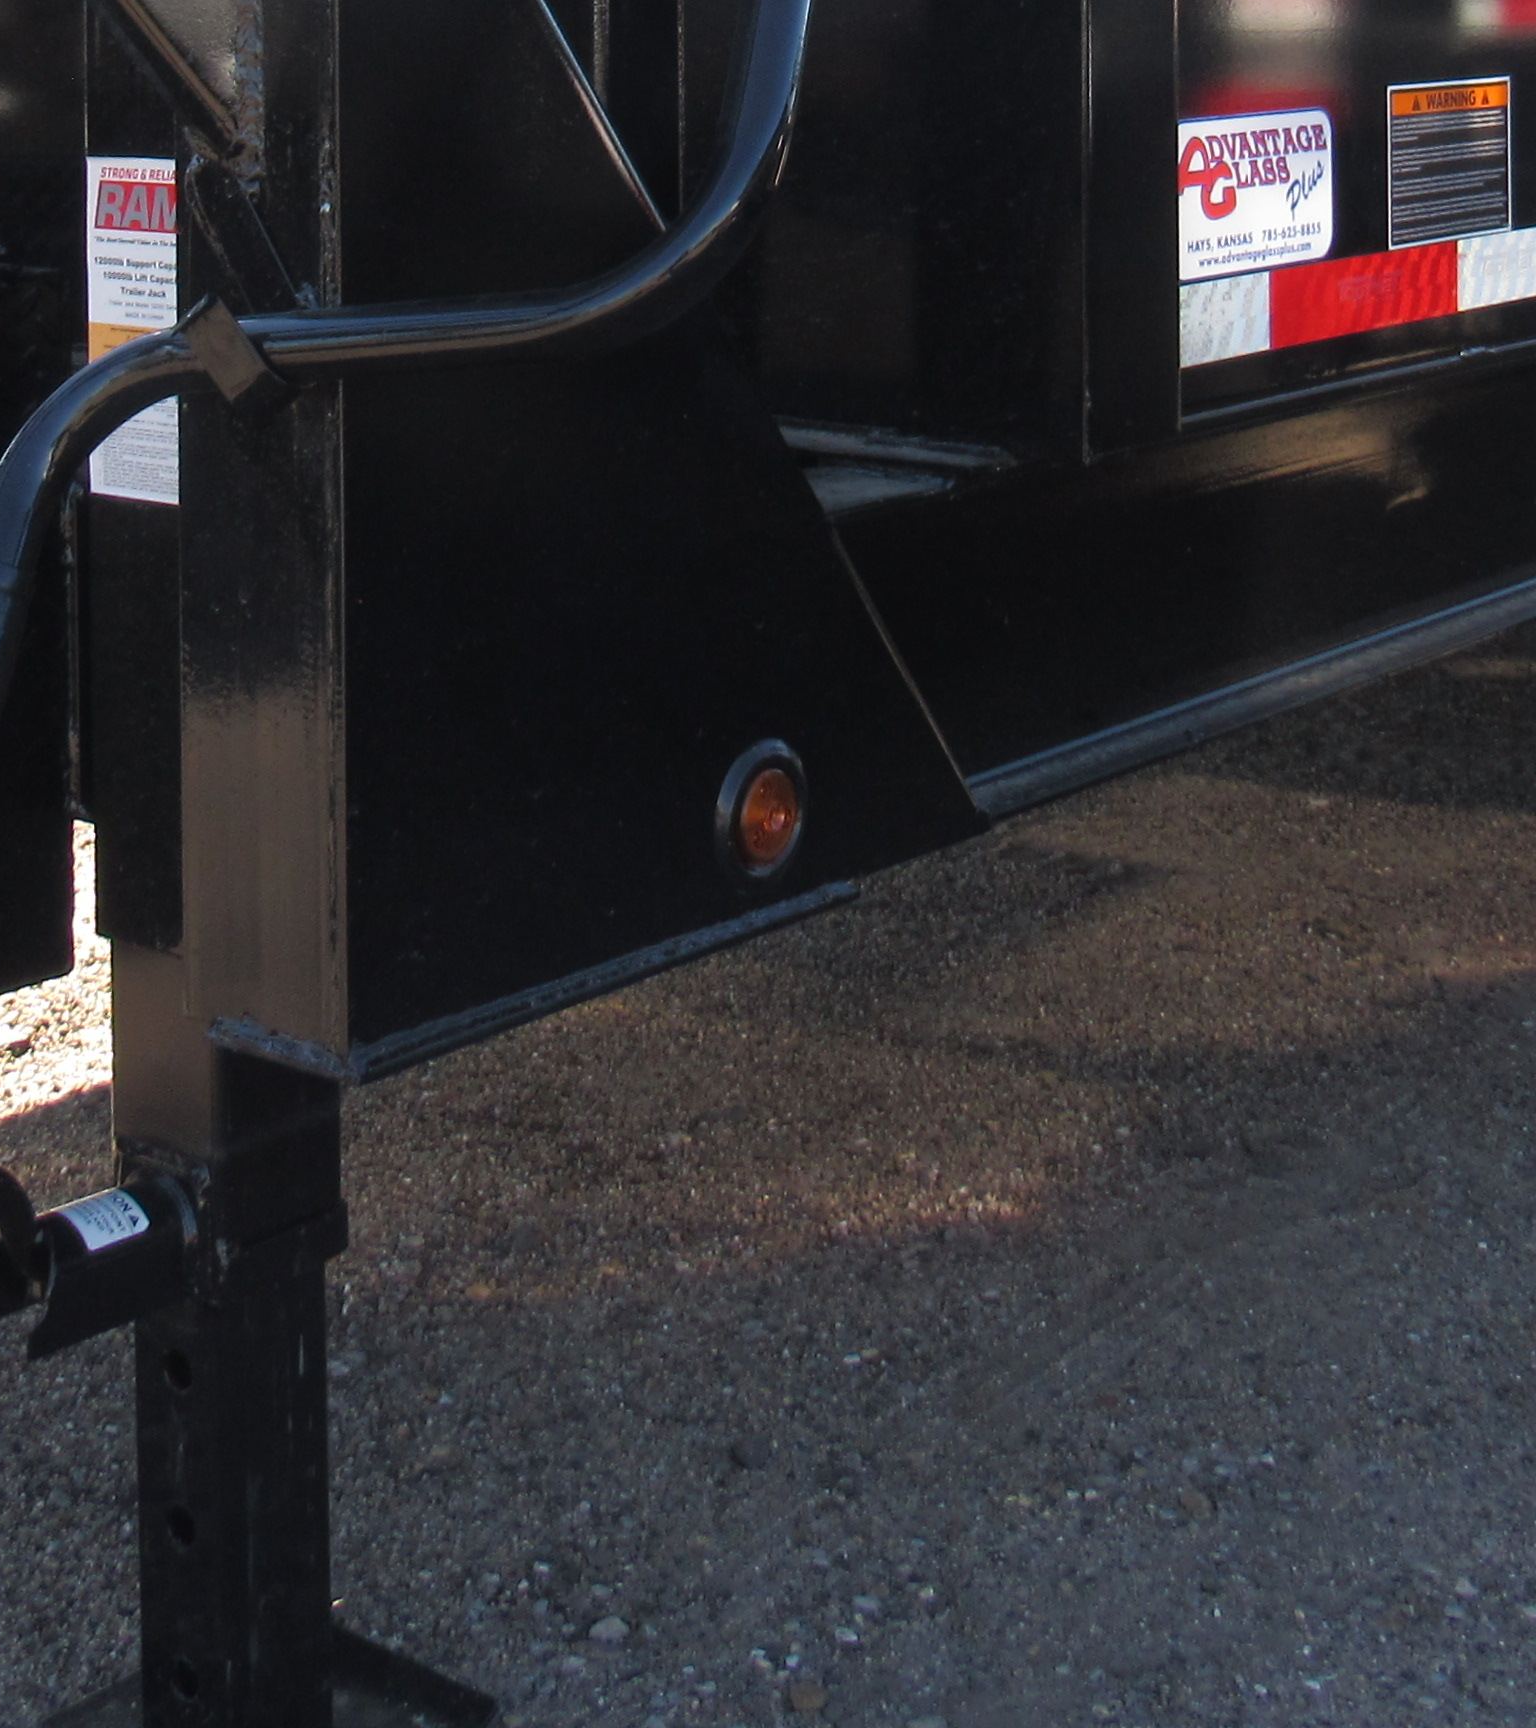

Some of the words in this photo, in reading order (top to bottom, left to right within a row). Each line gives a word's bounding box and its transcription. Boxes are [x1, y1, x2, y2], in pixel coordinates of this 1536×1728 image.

[1426, 89, 1475, 109] WARNING
[1178, 124, 1327, 195] ADVANTAGE
[100, 166, 138, 180] STRONG
[140, 168, 147, 181] &
[1201, 156, 1290, 220] GLASS
[1286, 160, 1324, 221] Plus
[97, 183, 177, 232] RAM
[1187, 239, 1215, 254] HAYS,
[1217, 232, 1253, 248] KANSAS
[1262, 222, 1321, 243] 785-625-8855
[126, 258, 156, 270] Support
[1198, 241, 1312, 268] www.advantageglassplus.com
[134, 272, 148, 282] Lift
[120, 286, 146, 297] Trailer
[148, 288, 166, 298] Jack
